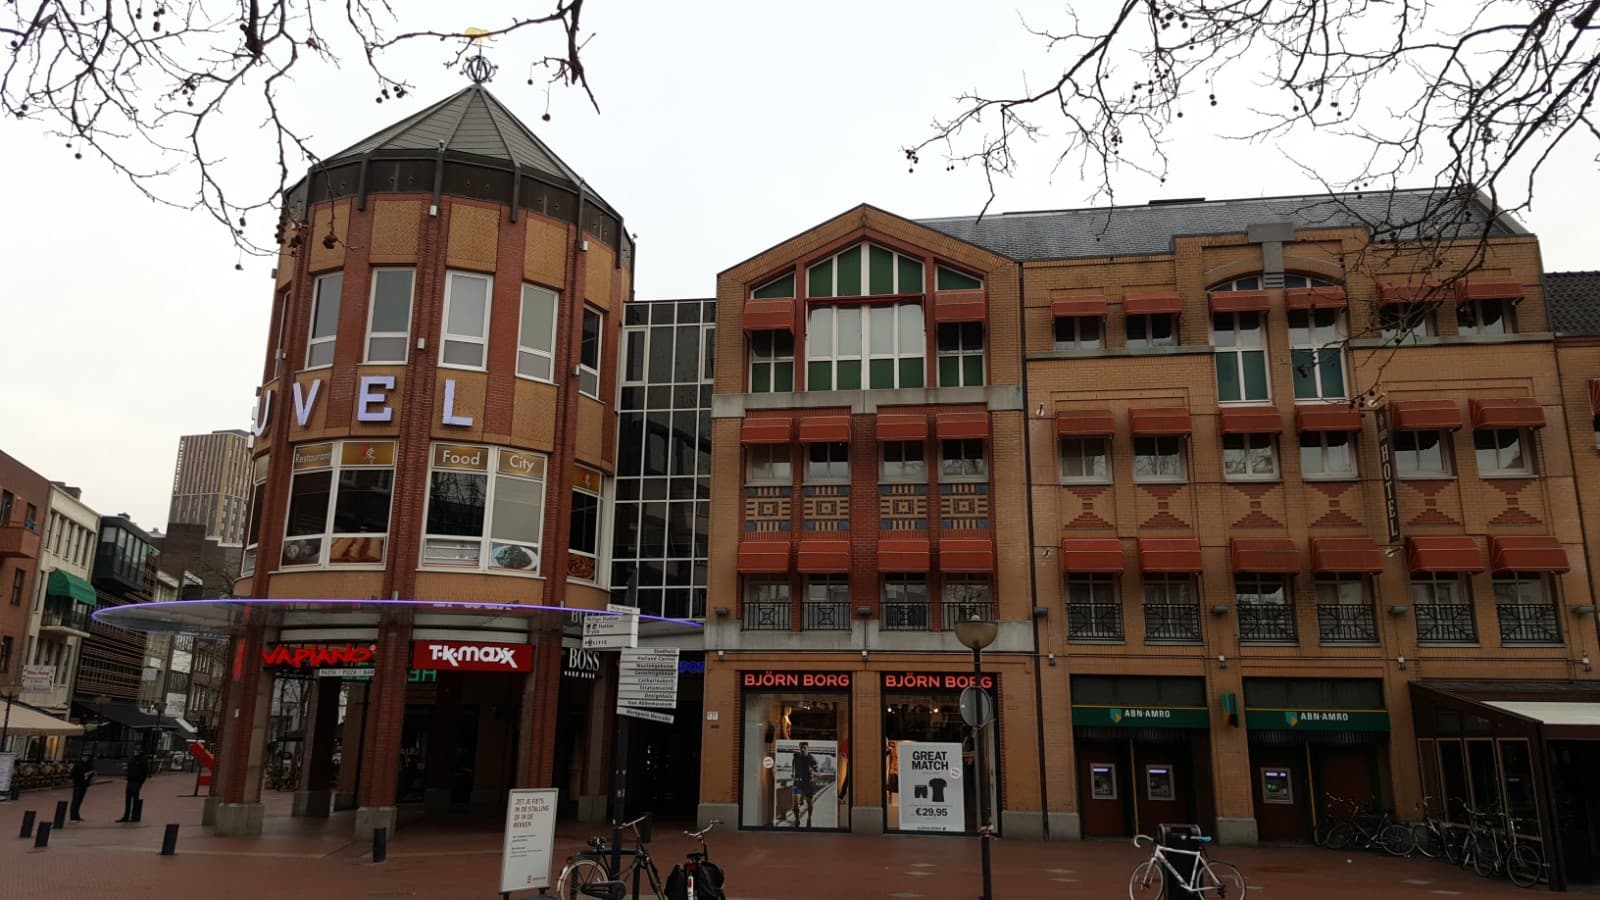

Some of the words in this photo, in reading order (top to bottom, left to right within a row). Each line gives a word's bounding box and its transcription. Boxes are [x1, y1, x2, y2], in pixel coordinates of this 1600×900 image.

[295, 452, 331, 464] Restaurant
[442, 450, 480, 465] Food
[509, 455, 535, 473] City
[1380, 444, 1398, 537] HOTEL
[262, 642, 372, 669] VAPIANO
[568, 647, 600, 671] BOSS
[744, 671, 798, 686] BJÖRN
[803, 674, 850, 687] BORG
[886, 672, 940, 688] BJÖRN
[912, 750, 948, 761] GREAT
[911, 760, 949, 771] MATCH
[528, 804, 550, 812] STALLING
[915, 807, 948, 817] €29.95
